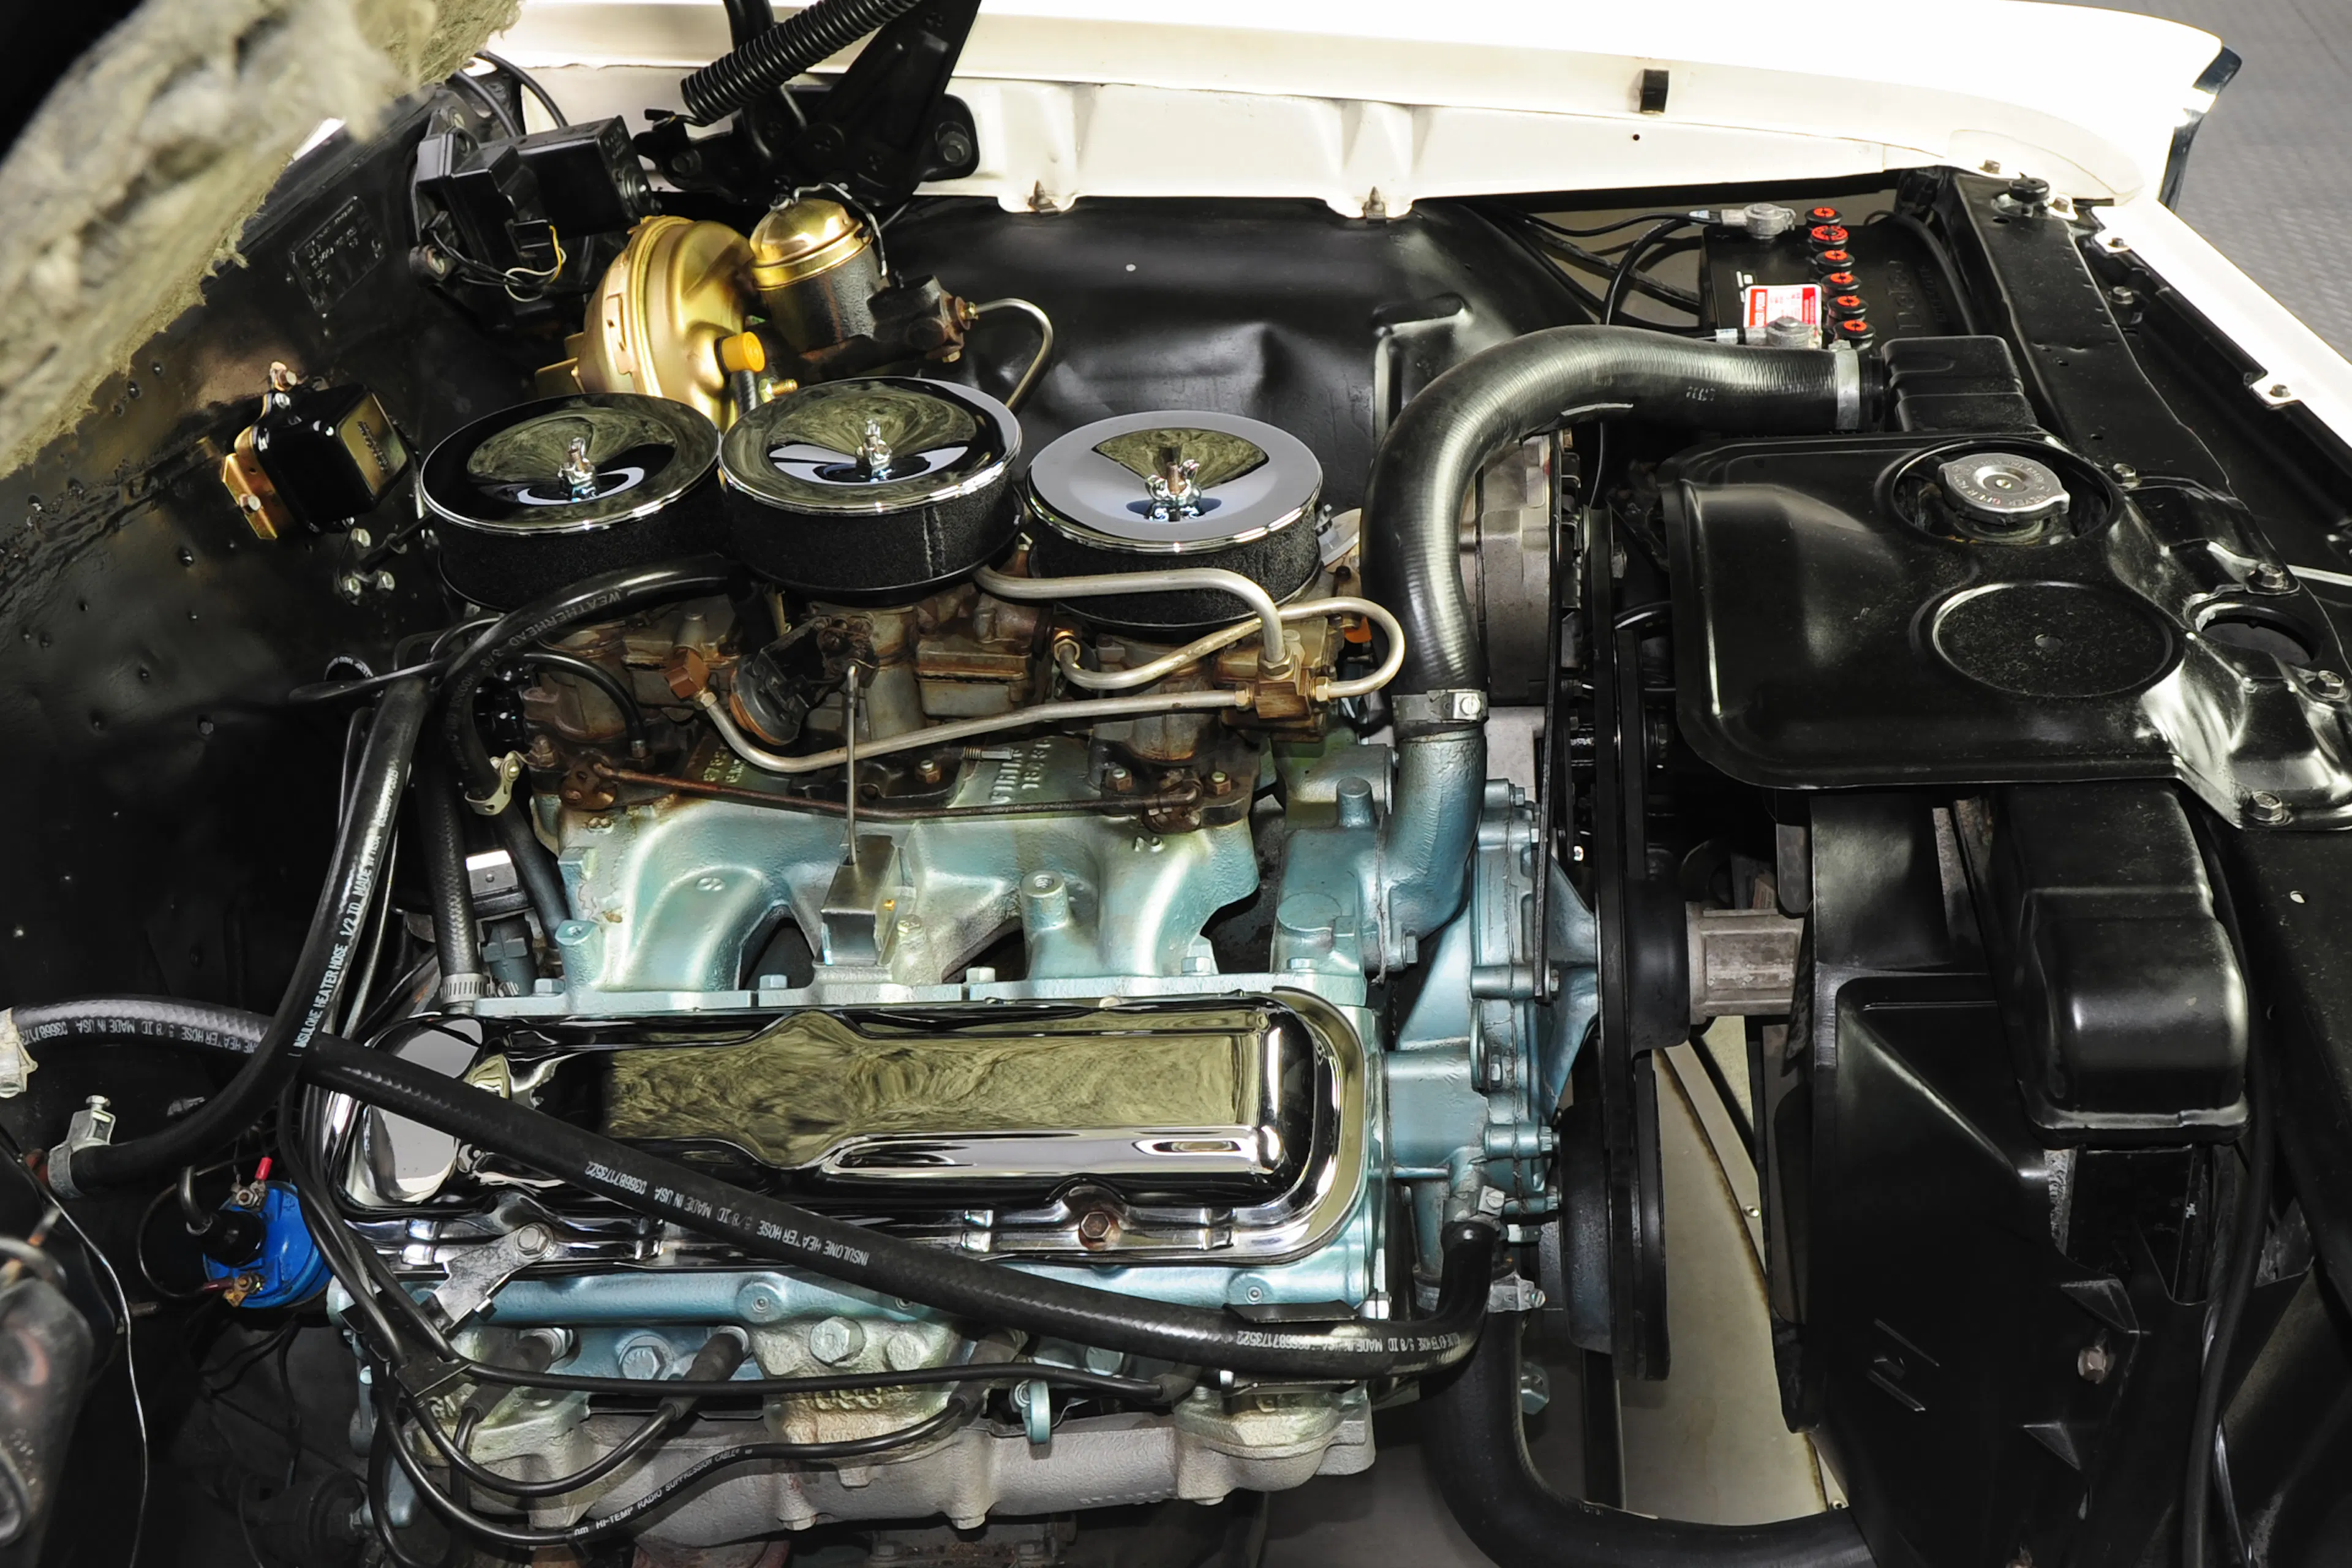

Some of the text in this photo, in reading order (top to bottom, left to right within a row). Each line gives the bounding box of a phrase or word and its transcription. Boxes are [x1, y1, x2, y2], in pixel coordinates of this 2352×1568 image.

[507, 590, 621, 648] WEATHERHEAD
[313, 968, 337, 1009] HEATER
[328, 944, 348, 974] HOSE
[340, 918, 357, 937] 1/2
[353, 869, 371, 897] MADE
[75, 1019, 94, 1031] USA
[97, 1019, 106, 1031] IN
[110, 1019, 135, 1032] MADE
[181, 1026, 204, 1042] HOSE
[205, 1031, 241, 1050] HEATER
[652, 1186, 674, 1204] USA
[672, 1193, 685, 1207] IN
[684, 1196, 714, 1217] MADE
[756, 1219, 784, 1240] HOSE
[780, 1227, 822, 1253] HEATER
[821, 1240, 869, 1265] INSULONE
[1357, 1337, 1382, 1352] MADE
[596, 1507, 633, 1529] HI-TEMP
[638, 1489, 662, 1510] RADIO
[665, 1458, 712, 1492] SUPPRESSION
